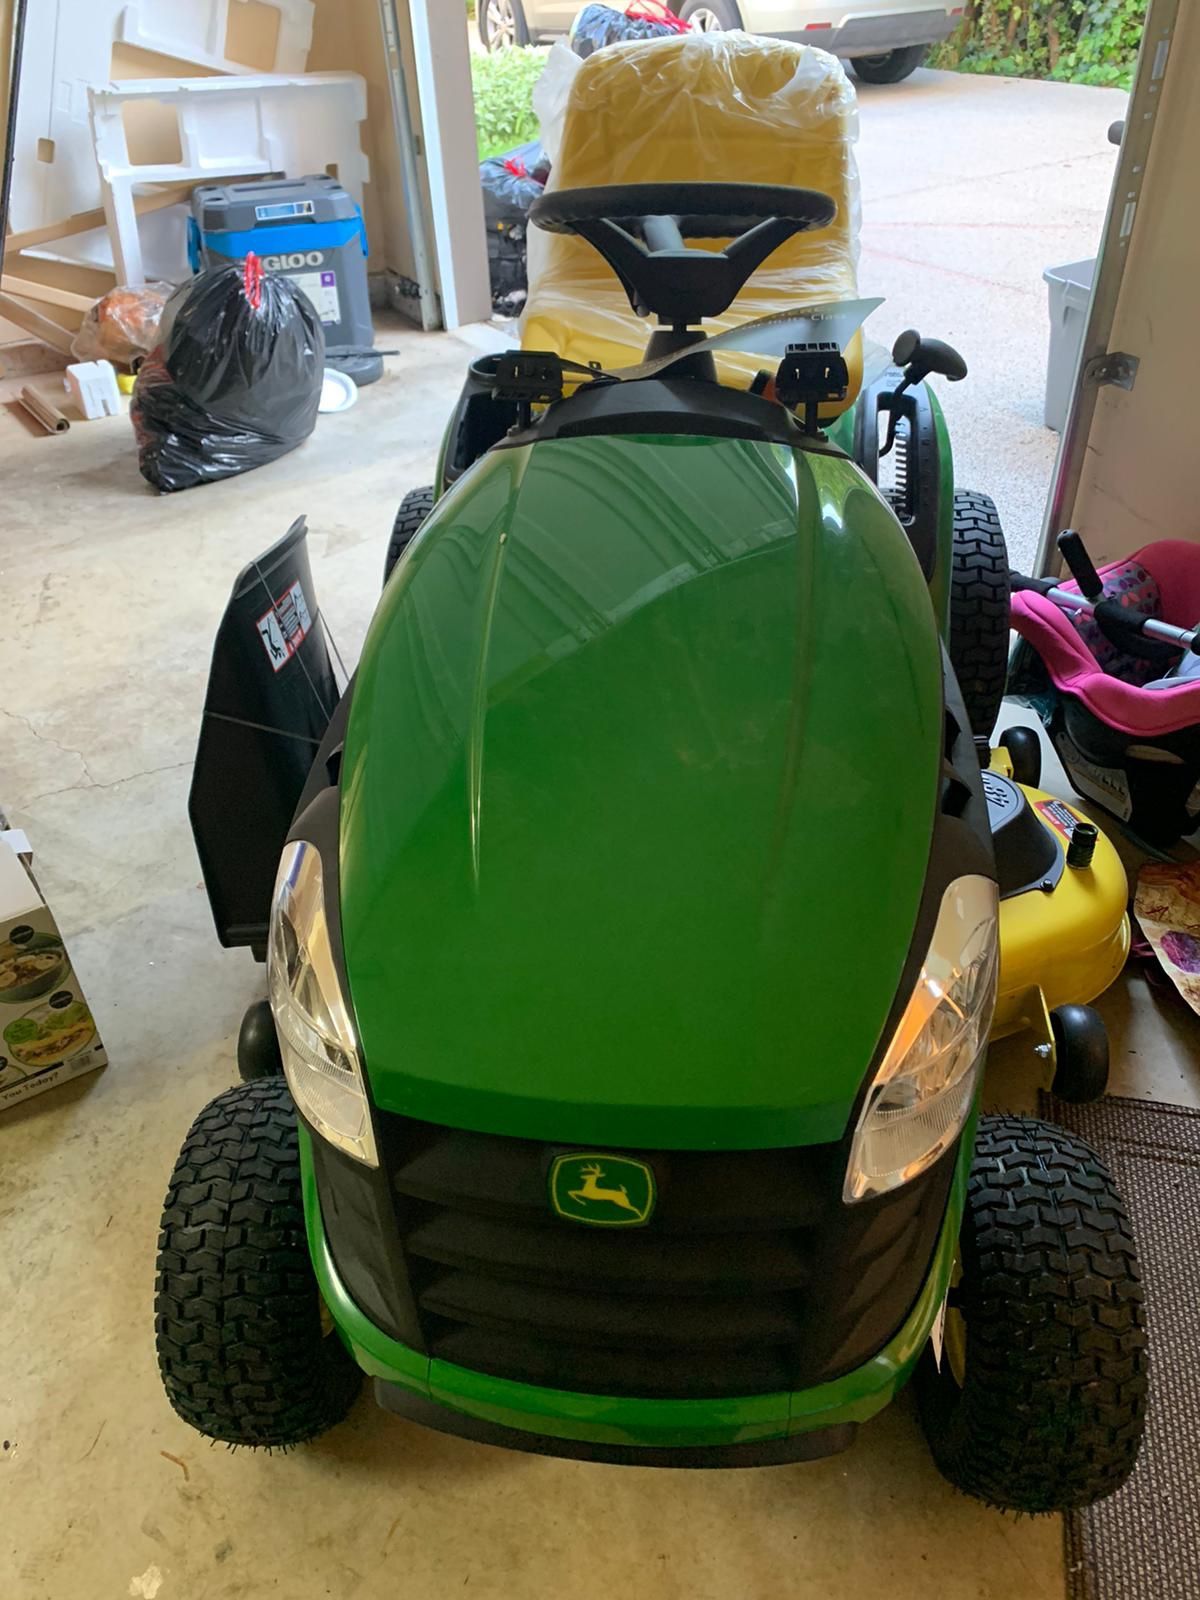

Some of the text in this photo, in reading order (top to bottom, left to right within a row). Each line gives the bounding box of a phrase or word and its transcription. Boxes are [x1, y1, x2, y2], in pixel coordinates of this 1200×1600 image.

[260, 251, 324, 271] GLOO
[2, 1071, 59, 1100] You Today?
